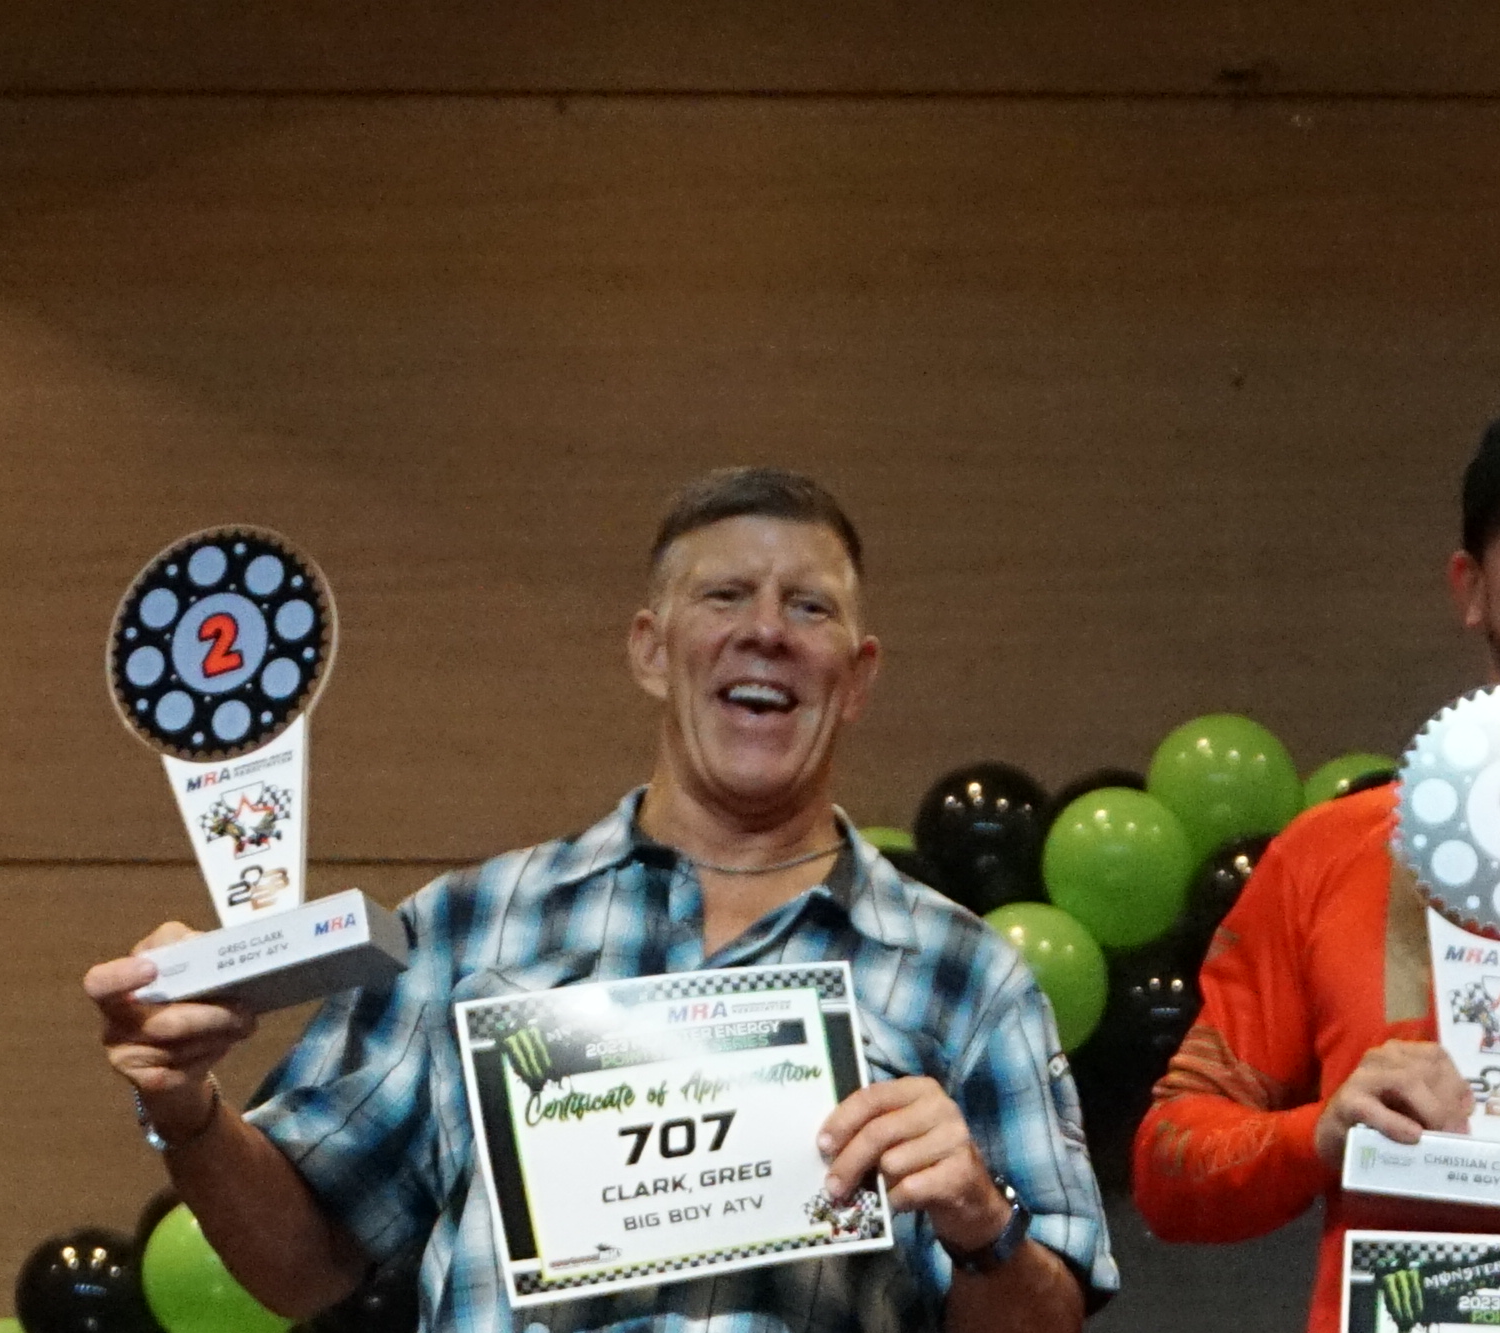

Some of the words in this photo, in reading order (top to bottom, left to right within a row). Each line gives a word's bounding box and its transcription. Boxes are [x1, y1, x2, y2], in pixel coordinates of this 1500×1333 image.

[199, 613, 243, 677] 2
[186, 767, 230, 792] MRA
[314, 913, 356, 936] MRA
[1445, 944, 1499, 967] MRA
[668, 1001, 728, 1023] MRA
[585, 1038, 629, 1058] 2023
[714, 1020, 780, 1039] ENERGY
[525, 1082, 636, 1127] Certificate
[647, 1080, 667, 1107] of
[618, 1108, 737, 1166] 707
[601, 1172, 693, 1204] CLARK,
[700, 1159, 773, 1188] GREG
[1473, 1174, 1500, 1187] BOY
[623, 1211, 660, 1232] BIG
[668, 1203, 713, 1223] BOY
[722, 1194, 765, 1216] ATV
[1457, 1296, 1500, 1311] 2023
